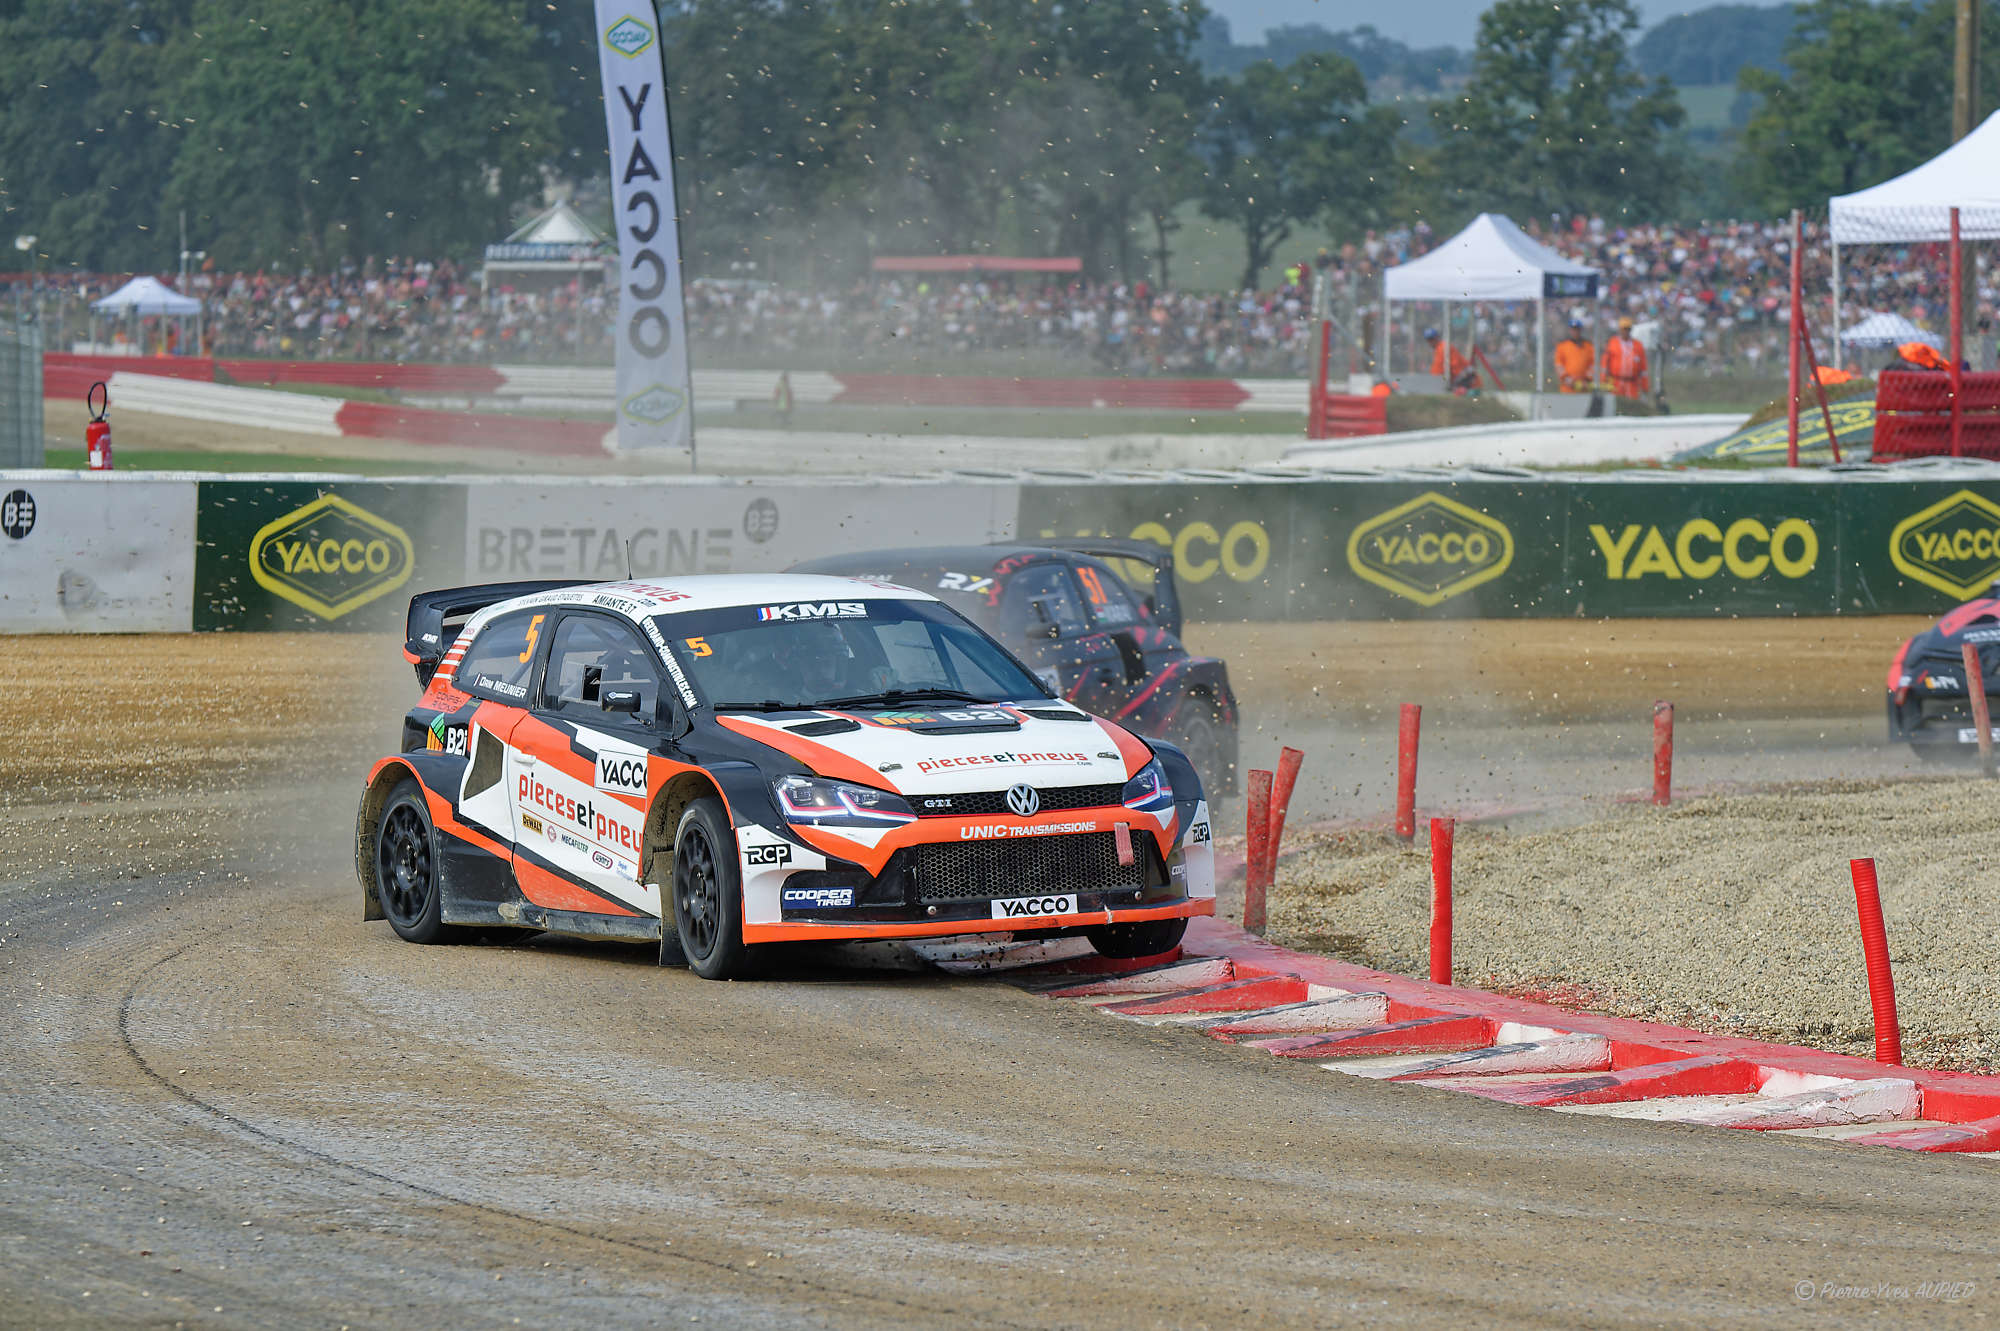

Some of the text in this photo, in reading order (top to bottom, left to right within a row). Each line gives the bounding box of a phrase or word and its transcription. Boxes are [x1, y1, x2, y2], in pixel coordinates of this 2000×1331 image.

[275, 538, 390, 574] YACCO
[478, 528, 733, 573] BRETAGNE
[1040, 521, 1270, 583] CCO
[1376, 532, 1489, 564] YACCO
[1588, 518, 1819, 580] YACCO
[592, 594, 629, 612] AMIANTE
[766, 602, 868, 620] KMS
[519, 615, 546, 664] 5
[685, 636, 713, 657] 5
[493, 680, 527, 698] MEUNIER
[917, 751, 1089, 773] piecesetpneus
[601, 759, 647, 788] YACC
[924, 799, 952, 808] GTI
[960, 822, 1096, 840] UNIC TRANSMISSIONS
[747, 846, 788, 869] RCP
[784, 889, 853, 901] COOPER
[816, 898, 852, 907] TIRES
[1000, 897, 1069, 916] YACCO
